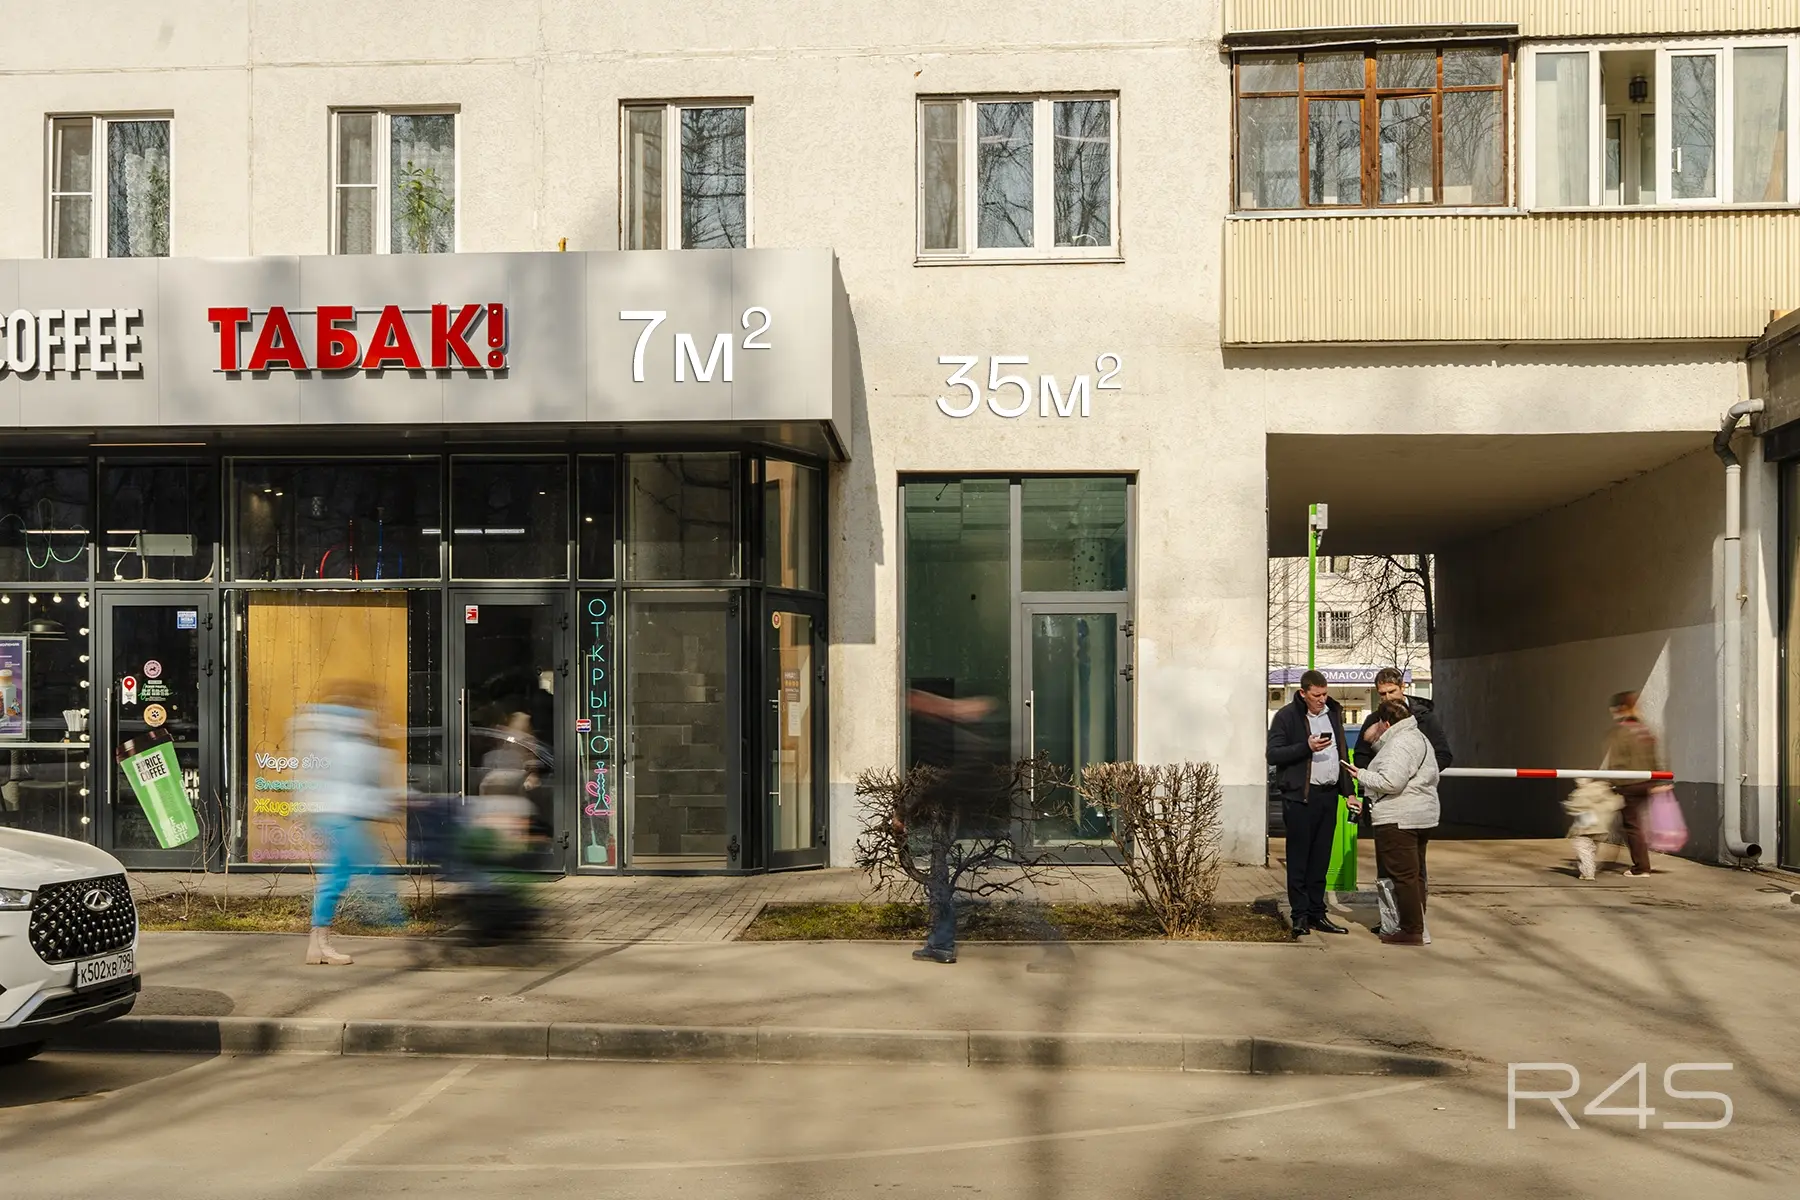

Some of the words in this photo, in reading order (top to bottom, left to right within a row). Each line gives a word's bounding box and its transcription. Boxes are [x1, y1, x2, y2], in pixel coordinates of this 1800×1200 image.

[0, 308, 140, 373] OFFEE
[208, 302, 505, 371] ТАБАК!
[588, 598, 609, 753] ОТКРЫТО
[140, 764, 167, 782] COFFEE
[141, 753, 163, 772] PRICE
[255, 752, 299, 773] Vape
[302, 753, 334, 770] sho
[118, 953, 131, 970] 799
